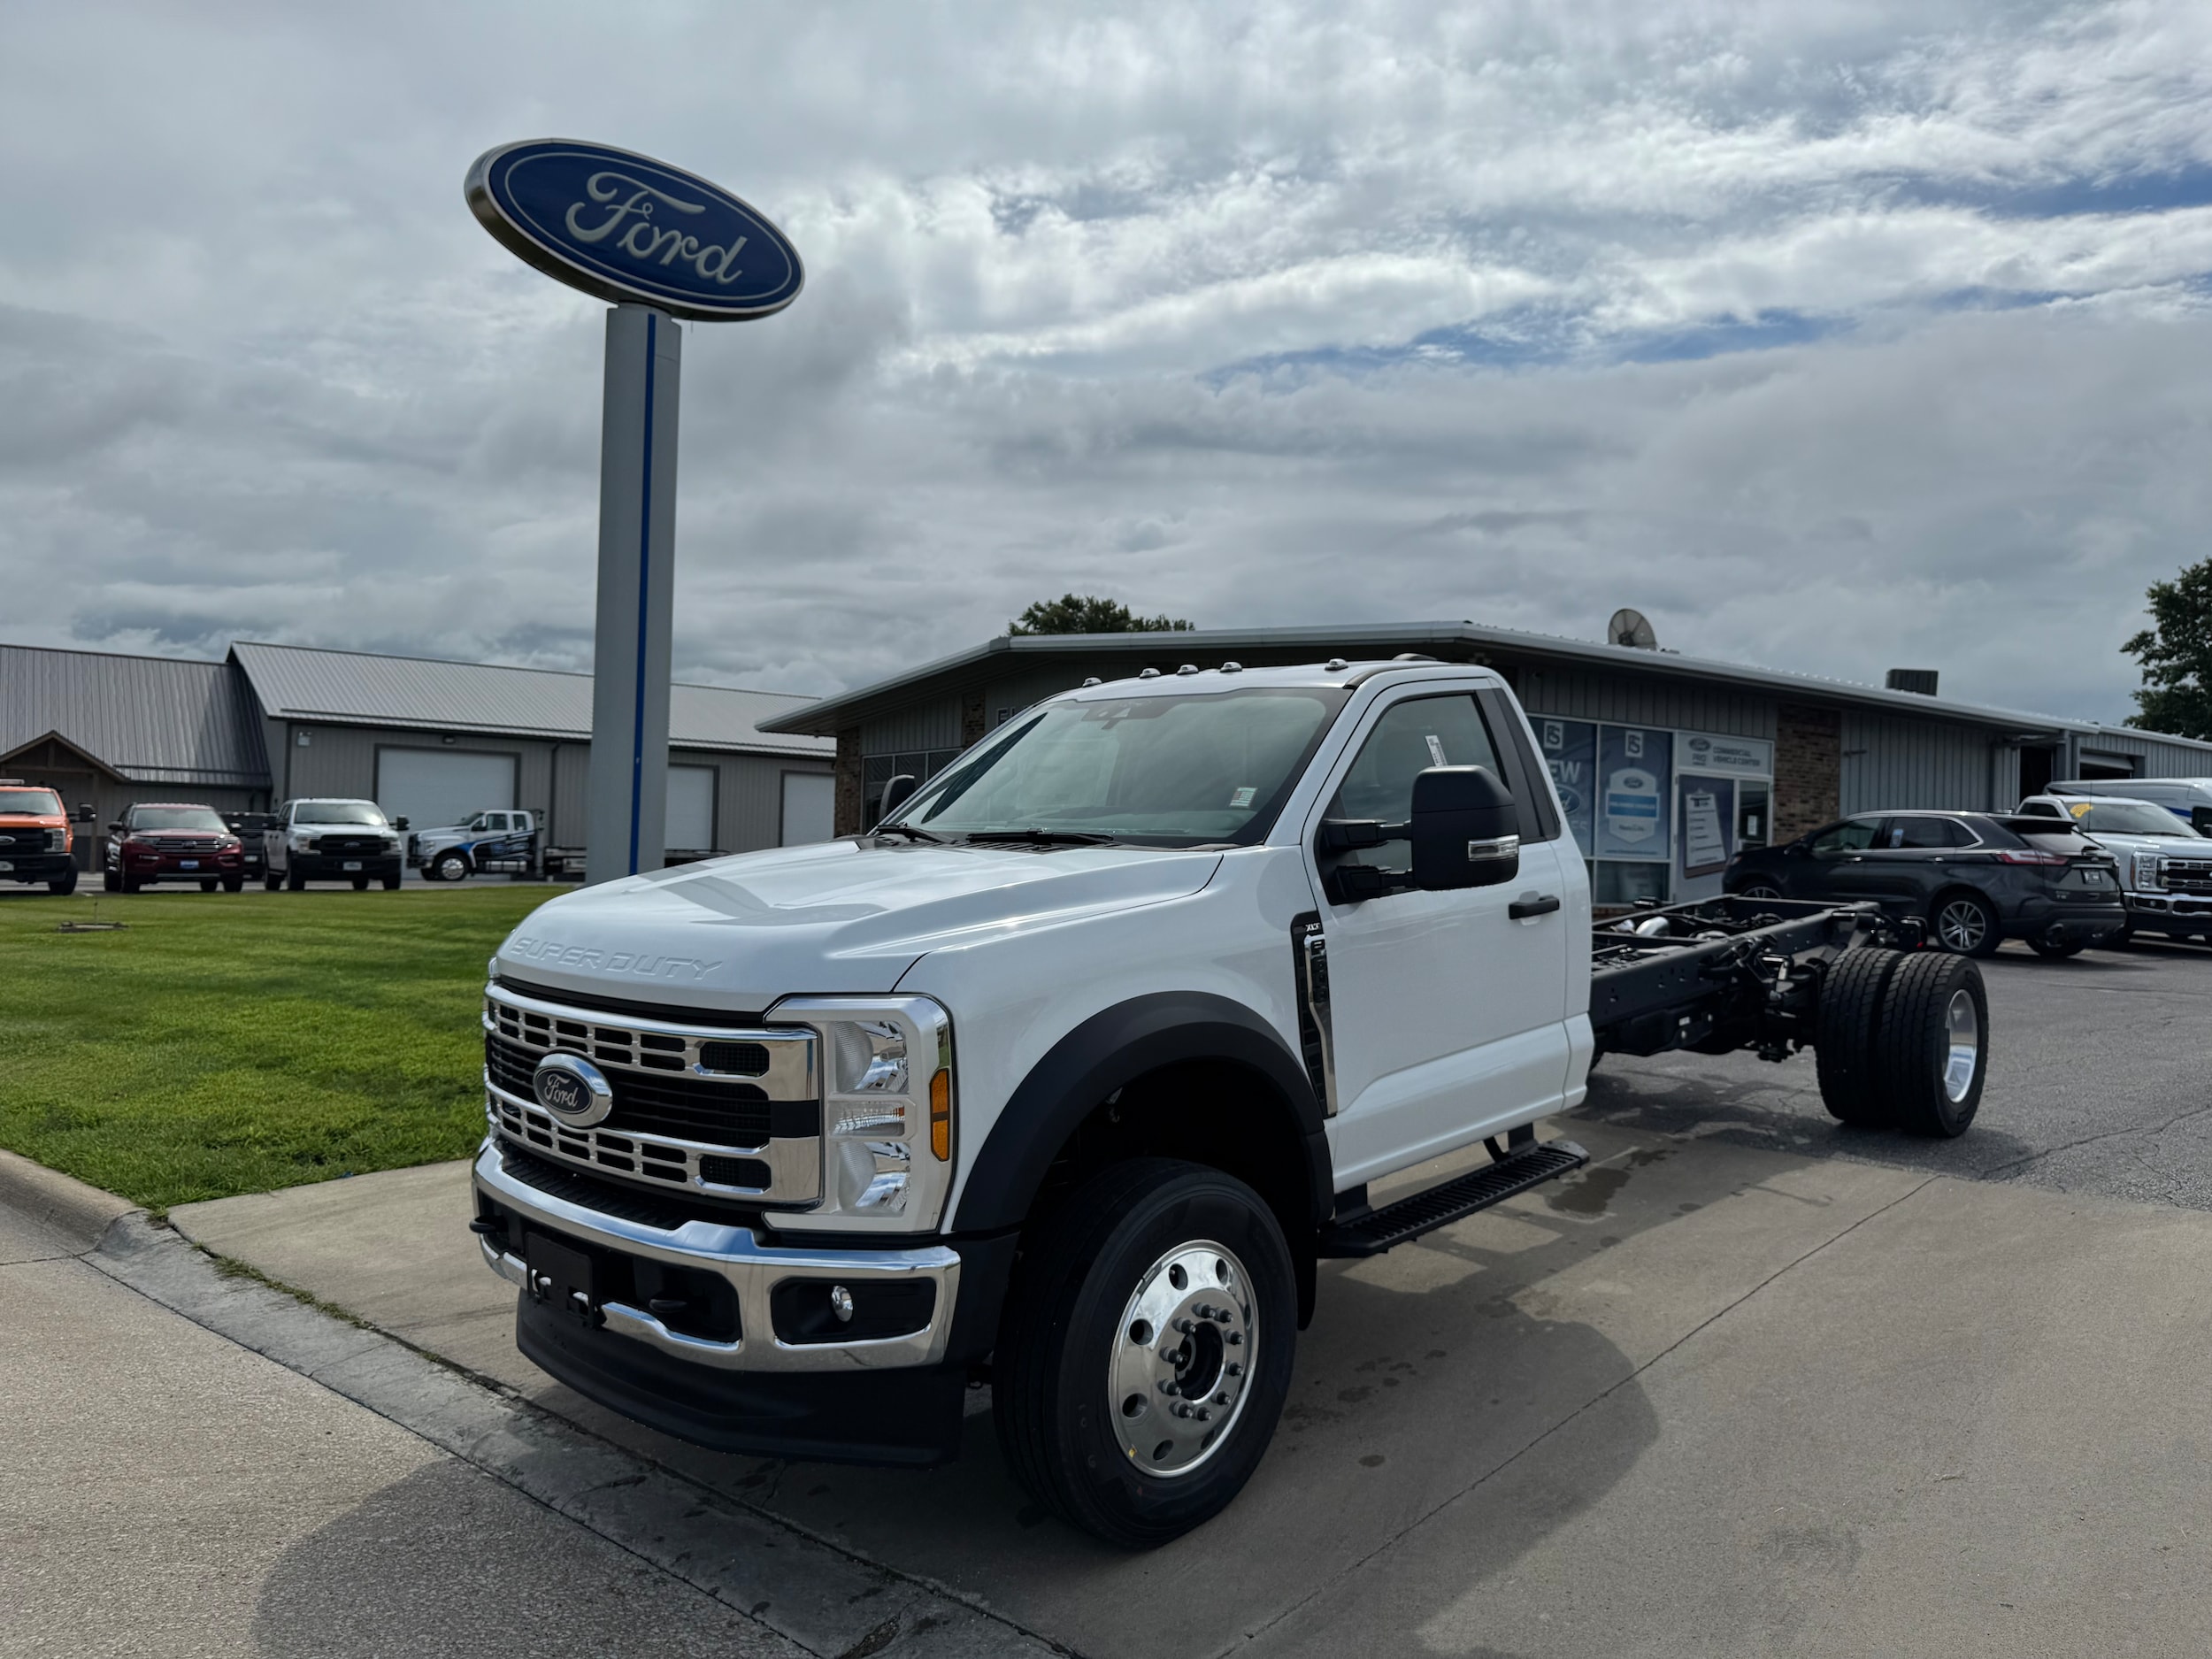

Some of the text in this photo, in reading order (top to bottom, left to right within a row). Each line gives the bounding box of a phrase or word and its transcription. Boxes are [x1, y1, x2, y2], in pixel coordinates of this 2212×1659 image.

[565, 172, 748, 284] Ford
[1547, 758, 1581, 784] EW
[511, 937, 723, 980] SUPER DUTY
[544, 1073, 579, 1107] Ford
